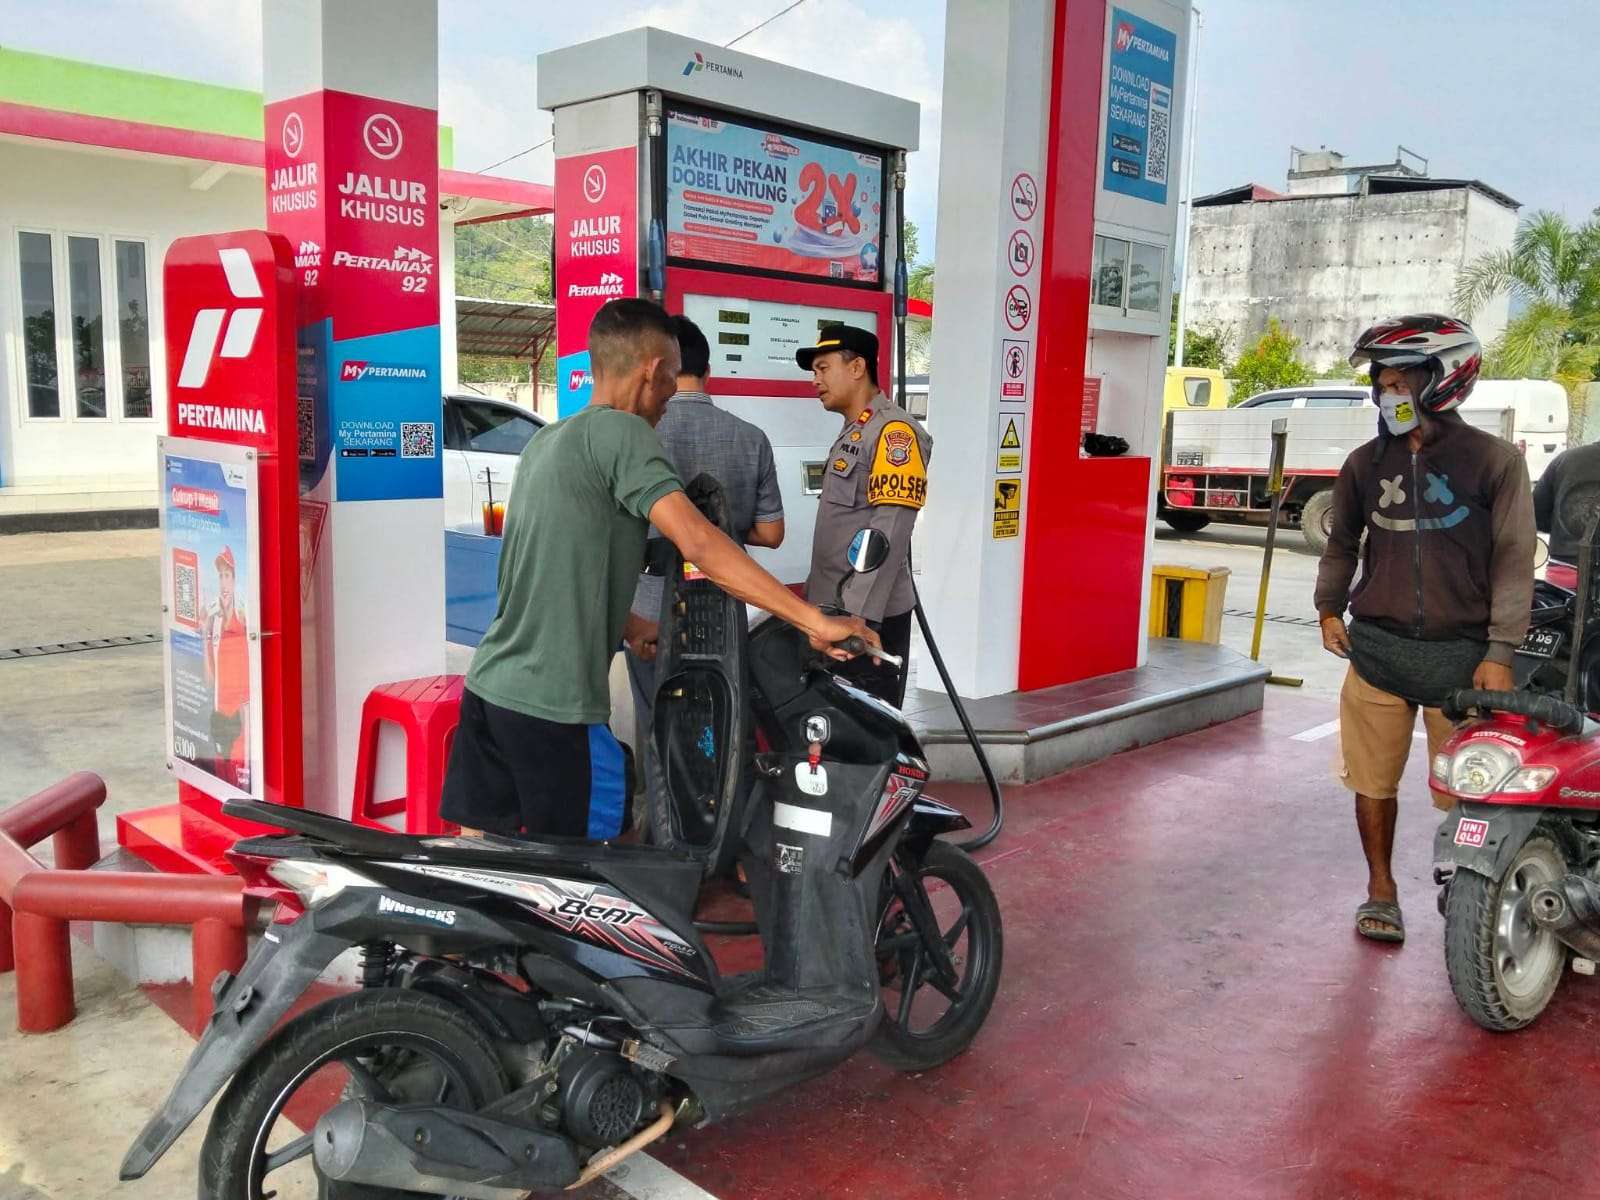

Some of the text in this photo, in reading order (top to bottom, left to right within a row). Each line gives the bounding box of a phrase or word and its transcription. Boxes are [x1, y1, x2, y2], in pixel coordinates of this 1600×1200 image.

[705, 61, 744, 79] PERTAMINA
[1112, 65, 1149, 92] DOWNLOAD
[1111, 104, 1146, 128] SEKARANG
[673, 145, 787, 185] AKHIR PEKAN
[271, 162, 317, 191] JALUR
[672, 167, 721, 191] DOBEL
[725, 179, 787, 203] UNTUNG
[338, 172, 427, 204] JALUR
[272, 190, 317, 214] KHUSUS
[341, 199, 425, 226] KHUSUS
[569, 215, 621, 238] JALUR
[571, 238, 620, 257] KHUSUS
[333, 251, 433, 274] PERTAMAX
[304, 269, 318, 286] 92
[401, 276, 428, 293] 92
[568, 284, 624, 297] PERTAMAX
[178, 403, 266, 433] PERTAMINA
[341, 421, 394, 430] DOWNLOAD
[343, 438, 393, 447] SEKARANG
[354, 429, 397, 438] Pertamina
[870, 490, 922, 502] BAOLAN
[1458, 831, 1482, 843] QLO
[1462, 822, 1483, 834] UNI
